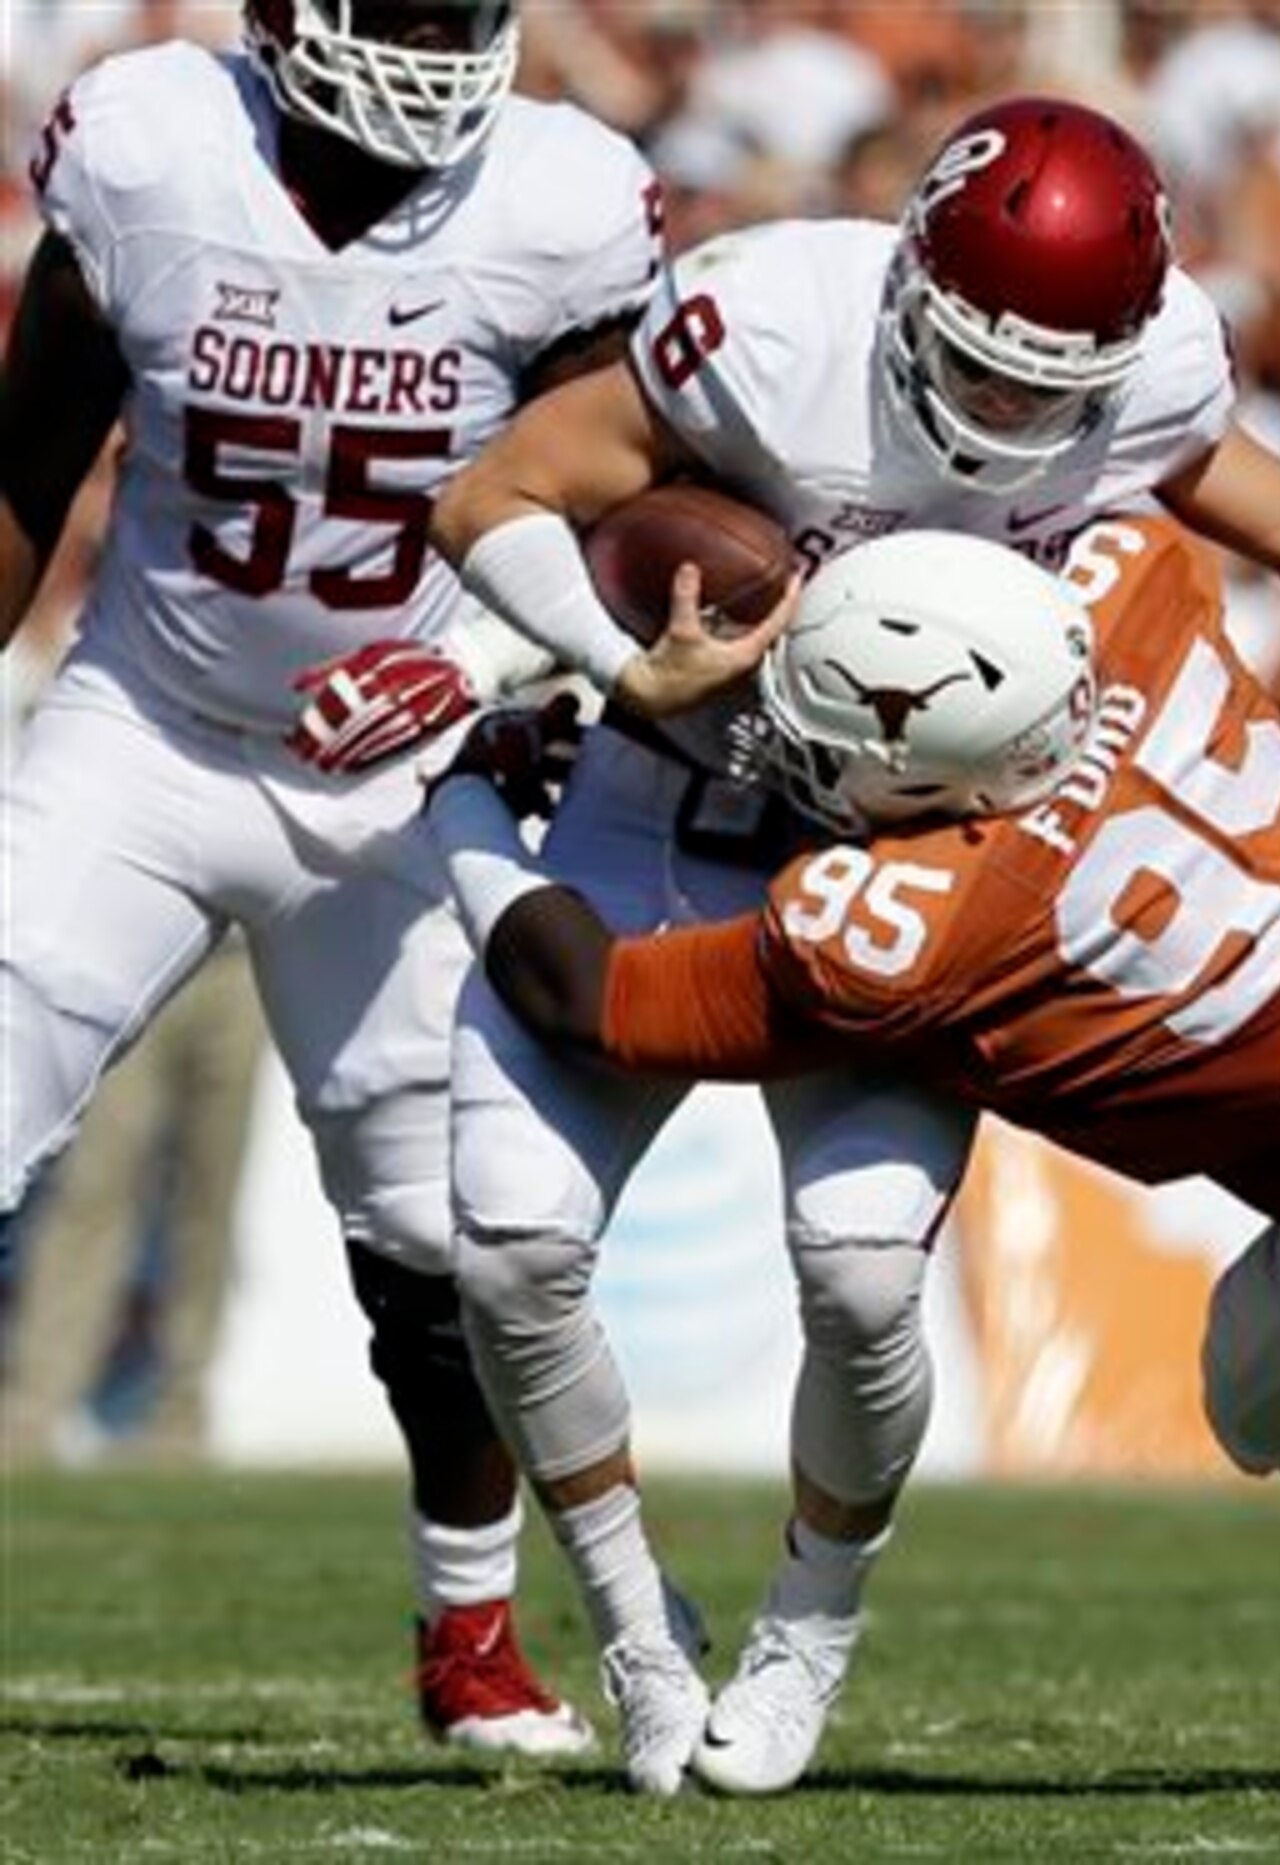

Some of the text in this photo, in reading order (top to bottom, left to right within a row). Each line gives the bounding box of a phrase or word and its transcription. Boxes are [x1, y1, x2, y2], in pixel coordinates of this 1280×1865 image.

[188, 325, 462, 414] SOONERS
[184, 404, 454, 612] 55
[782, 843, 955, 978] 95
